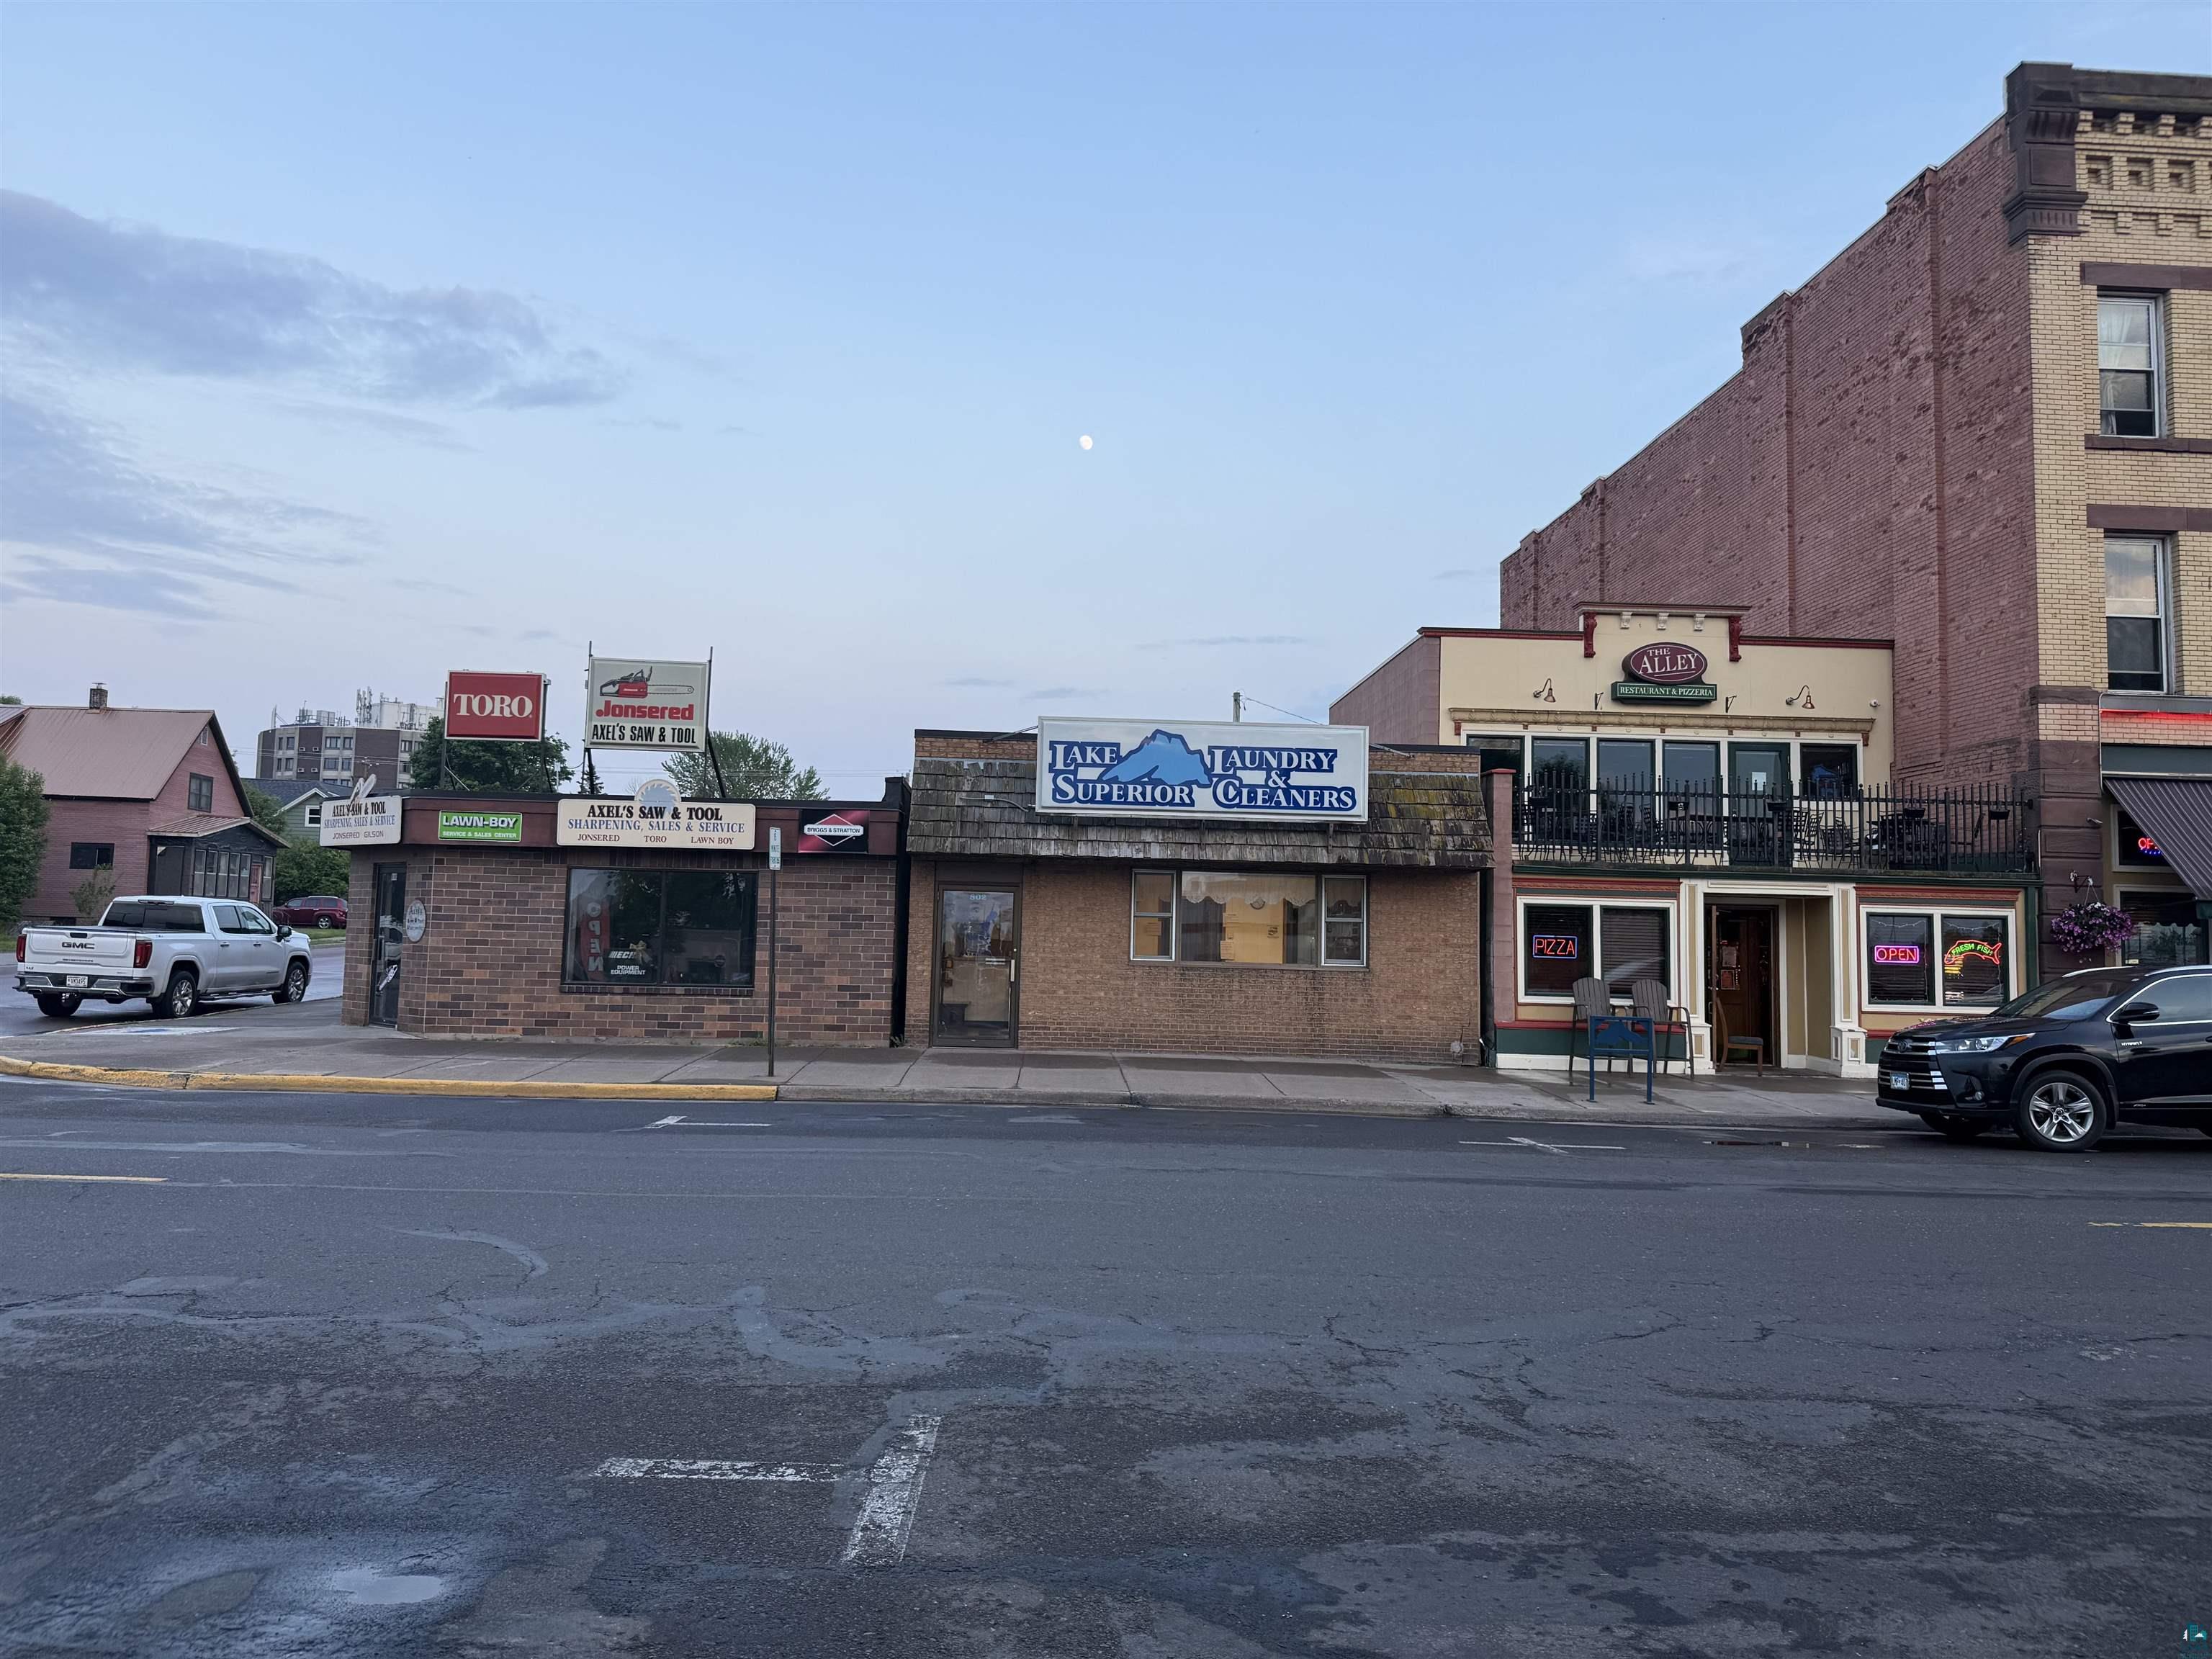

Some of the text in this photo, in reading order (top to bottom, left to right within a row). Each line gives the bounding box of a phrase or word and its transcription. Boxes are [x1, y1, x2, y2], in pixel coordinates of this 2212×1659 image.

[1647, 648, 1671, 657] THE
[1638, 652, 1699, 674] ALLEY
[1620, 686, 1671, 695] RESTAURANT
[1678, 688, 1713, 696] PIZZERIA
[454, 693, 533, 718] TORO
[595, 700, 694, 721] Jonsered
[592, 723, 696, 744] AXEL'S SAW & TOOL
[1051, 743, 1119, 770] LAKE
[1210, 747, 1335, 775] LAUNDRY
[1267, 770, 1287, 788] &
[1055, 773, 1192, 804] SUPERIOR
[1215, 778, 1354, 809] CLEANERS
[332, 801, 387, 817] AXEL'S SAW & TOOL
[588, 804, 723, 821] AXEL'S SAW & TOOL
[324, 814, 396, 829] SHARPENING, SALES & SERVICE
[442, 815, 518, 829] LAWN-BOY
[567, 819, 745, 833] SHARPENING, SALES & SERVICE
[2138, 837, 2157, 849] OP
[1534, 938, 1575, 956] PIZZA
[1876, 948, 1917, 961] OPEN
[1951, 943, 1994, 956] FRESH FISH
